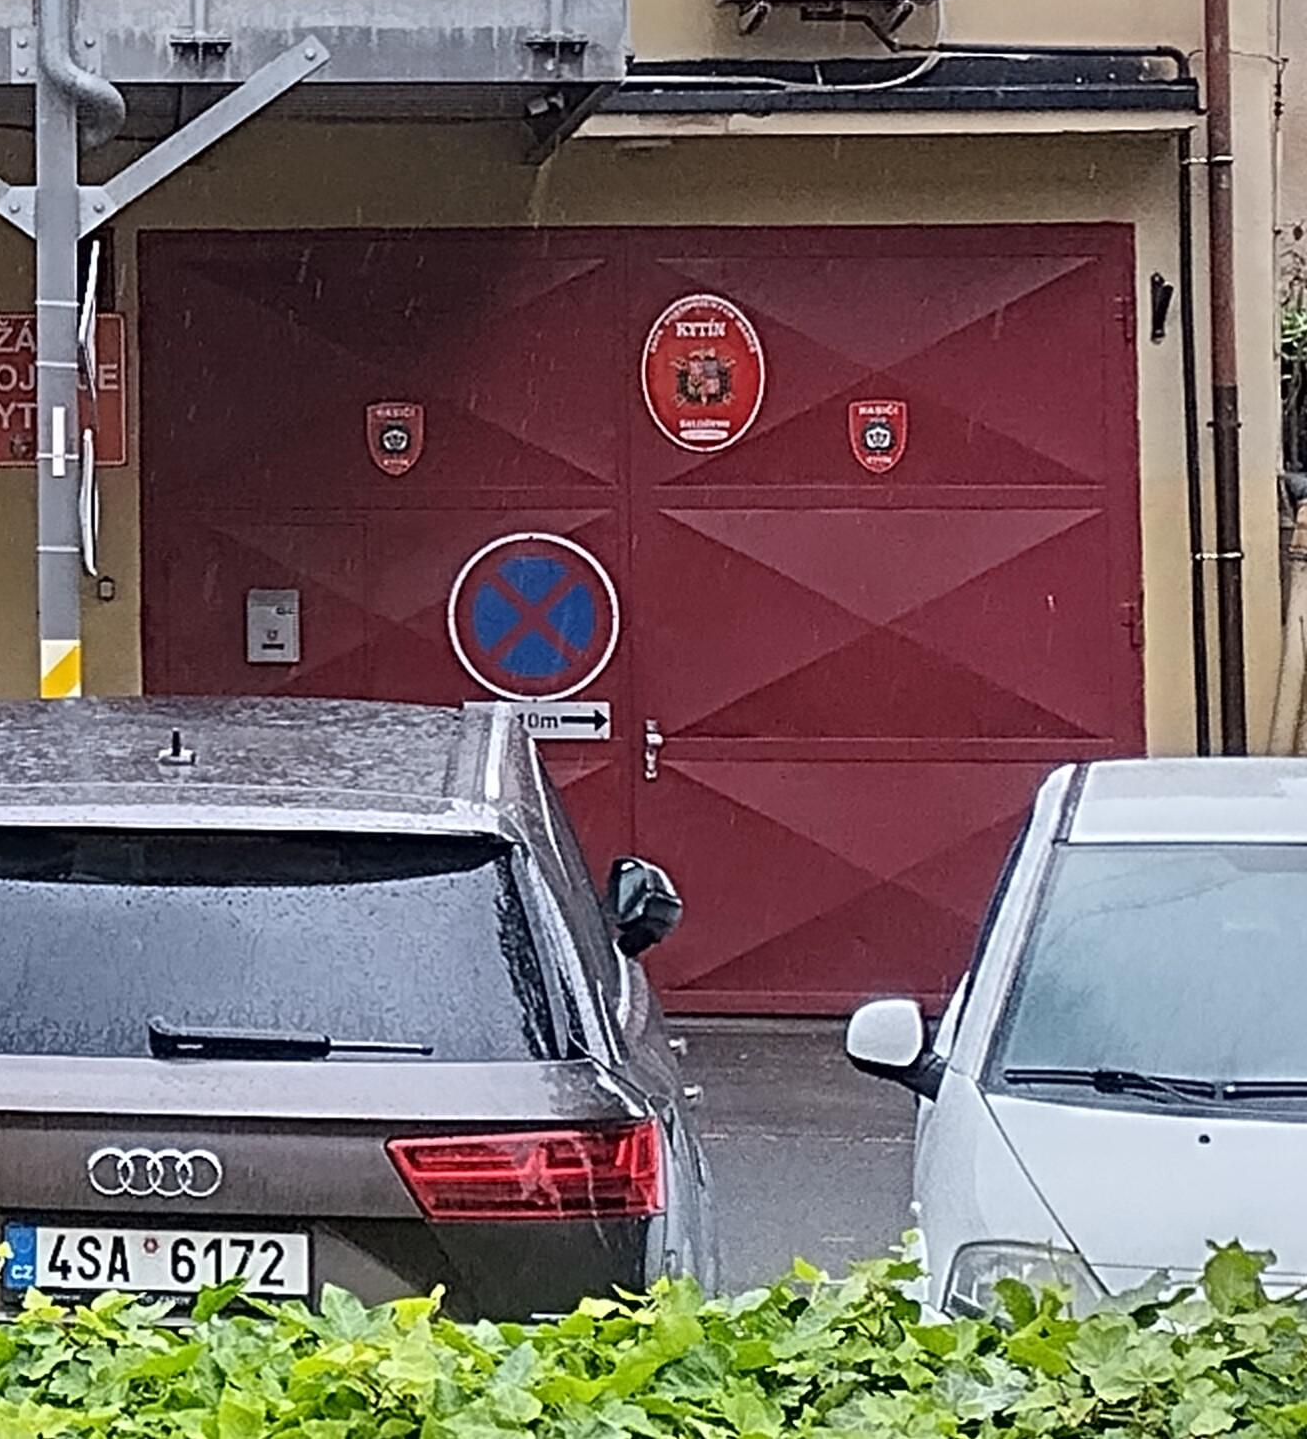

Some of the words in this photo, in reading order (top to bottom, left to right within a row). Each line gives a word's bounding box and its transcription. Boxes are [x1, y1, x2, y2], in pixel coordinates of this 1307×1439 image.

[11, 1264, 35, 1280] CZ
[47, 1234, 131, 1283] 4SA
[170, 1237, 285, 1287] 6172
